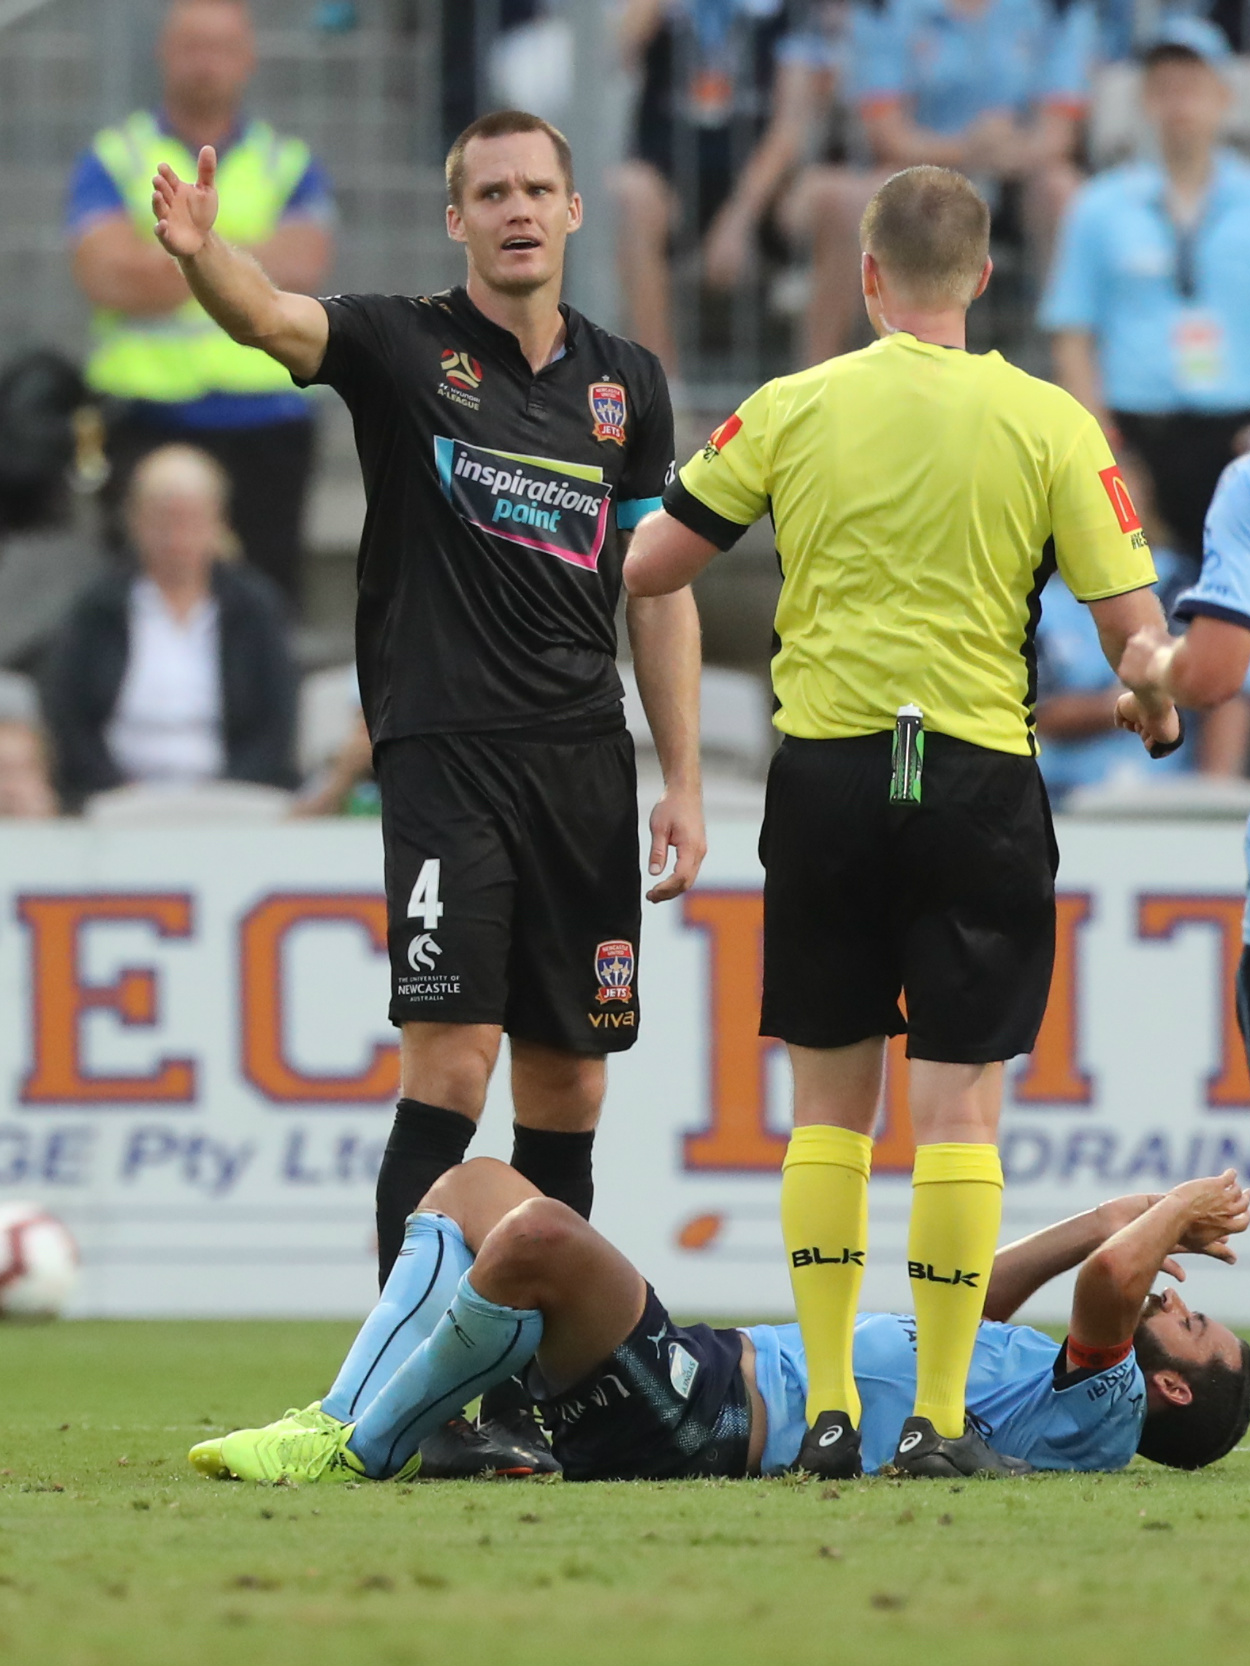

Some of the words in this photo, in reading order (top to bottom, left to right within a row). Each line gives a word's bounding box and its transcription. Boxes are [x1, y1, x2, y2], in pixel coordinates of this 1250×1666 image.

[437, 388, 480, 411] A-LEAGUE
[601, 425, 621, 438] JETS
[454, 451, 602, 517] inspirations
[491, 498, 562, 533] paint
[407, 858, 444, 930] 4
[450, 974, 460, 982] OF
[398, 983, 461, 995] NEWCASTLE
[603, 987, 627, 998] JETS
[588, 1010, 635, 1028] viva
[792, 1247, 866, 1268] BLK
[907, 1261, 981, 1288] BLK
